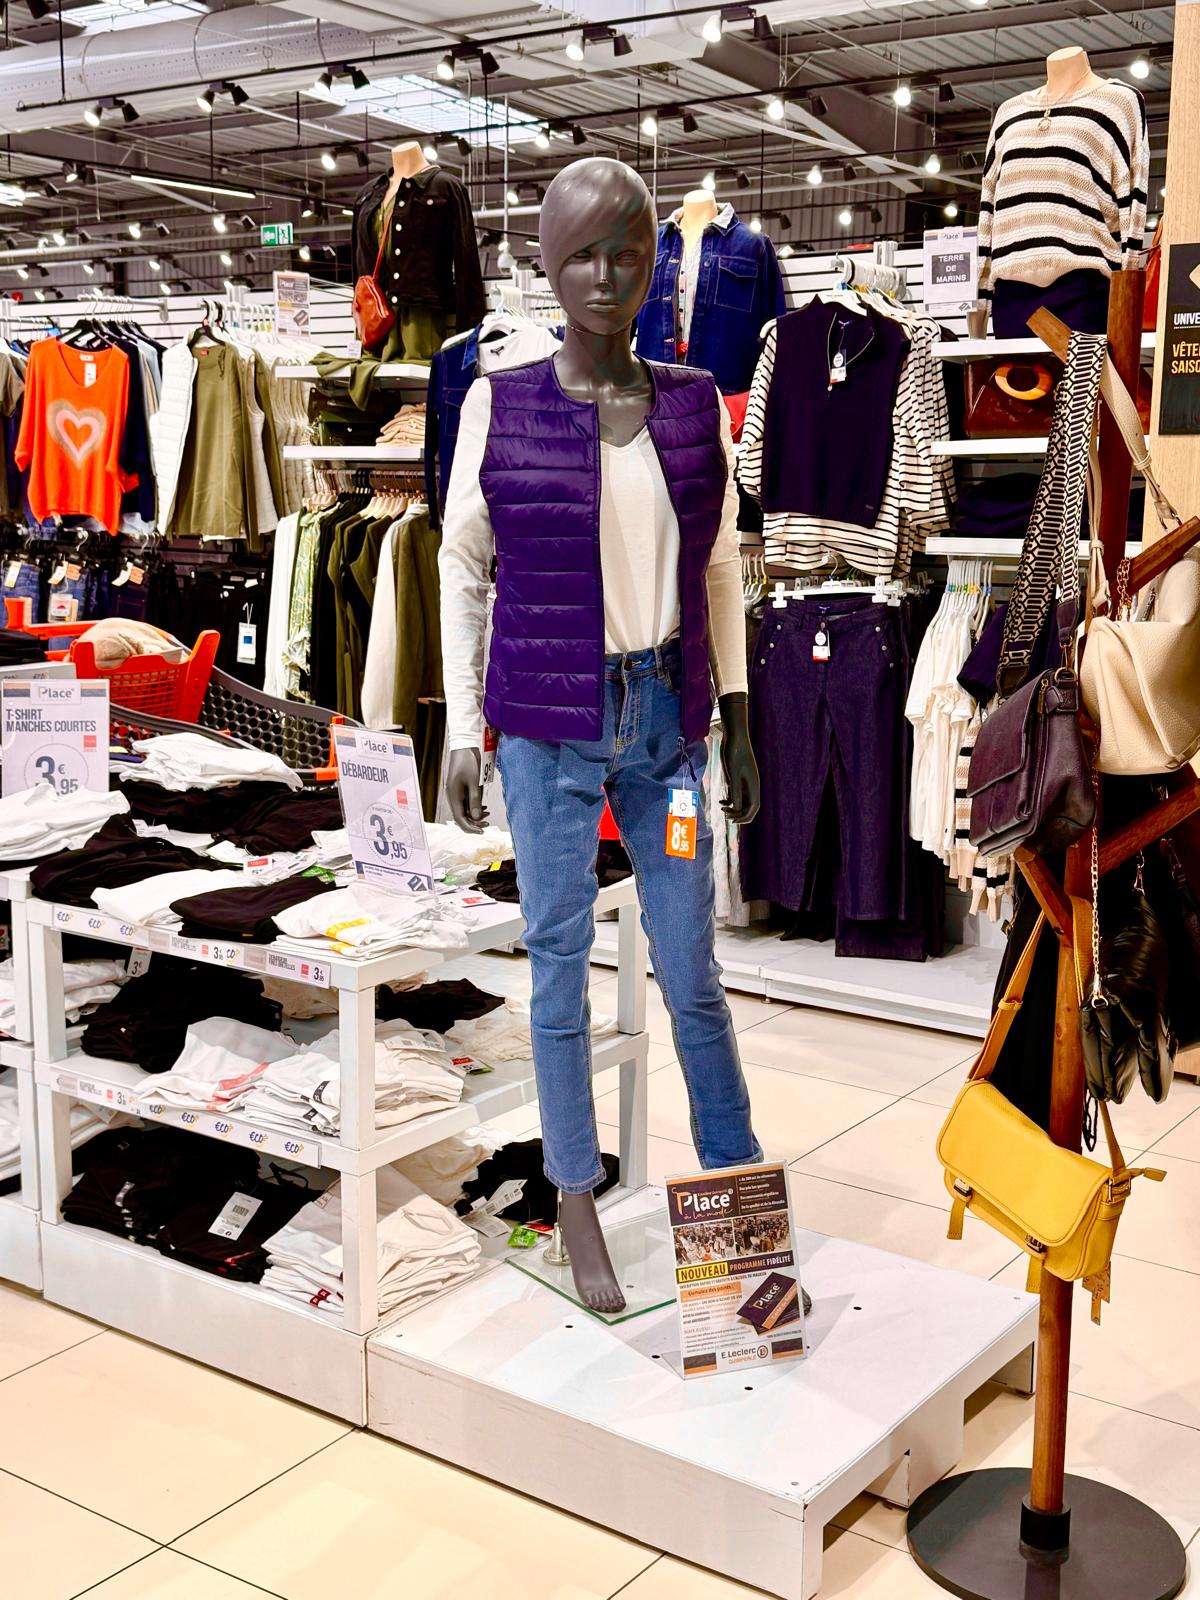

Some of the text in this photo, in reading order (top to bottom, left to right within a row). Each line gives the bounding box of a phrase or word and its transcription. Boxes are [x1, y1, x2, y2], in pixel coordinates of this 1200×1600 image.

[938, 254, 965, 263] TERRE
[945, 265, 957, 273] DE
[936, 274, 967, 283] MARINS
[1172, 341, 1200, 358] VÊTE
[6, 708, 43, 720] T-SHIRT
[6, 720, 52, 732] MANCHES
[54, 720, 97, 732] COURTES
[341, 759, 390, 784] DÉBARDEUR
[672, 1187, 731, 1216] Place
[706, 1206, 733, 1218] mode
[681, 1263, 726, 1280] NOUVEAU
[729, 1260, 766, 1272] PROGRAMME
[766, 1255, 791, 1266] FIDÉLITÉ
[752, 1286, 780, 1309] Place
